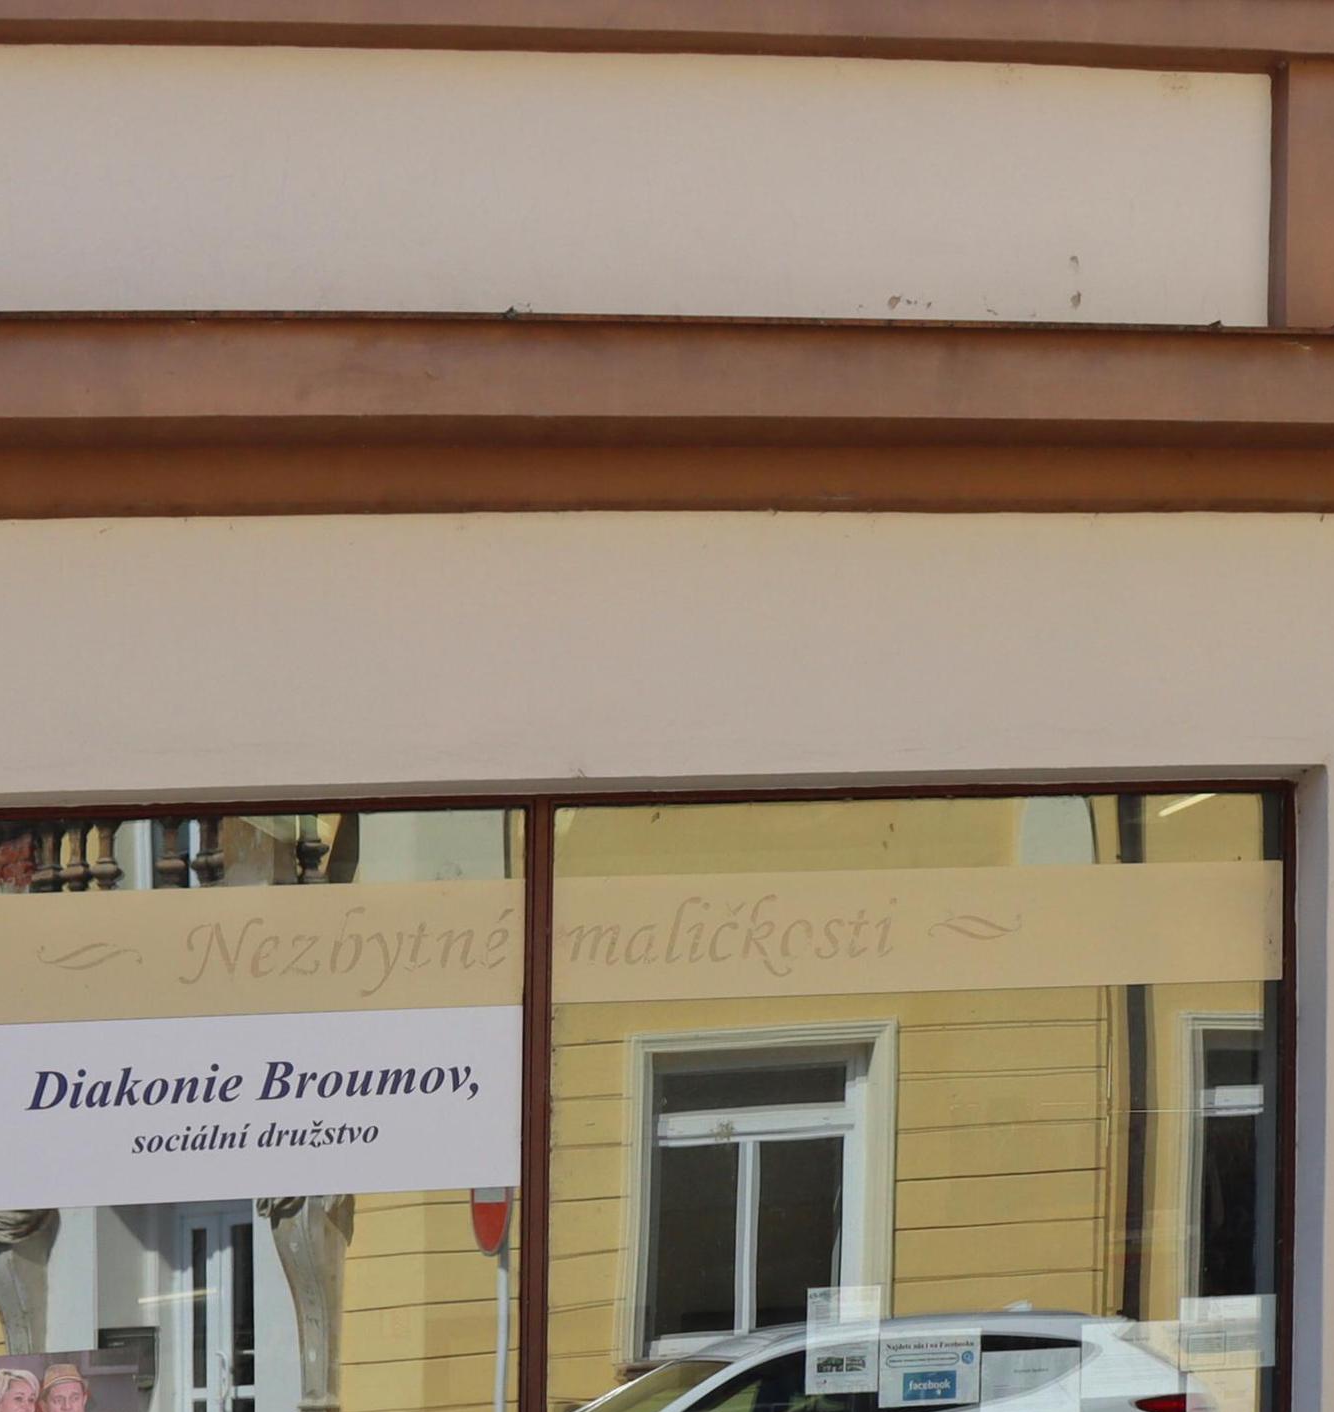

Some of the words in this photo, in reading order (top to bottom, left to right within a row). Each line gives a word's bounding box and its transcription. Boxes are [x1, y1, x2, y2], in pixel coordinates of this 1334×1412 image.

[178, 905, 517, 997] Nezbytné
[563, 892, 898, 977] maličkosti
[27, 1063, 242, 1112] Diakonie
[255, 1058, 482, 1103] Broumov,
[131, 1123, 249, 1155] sociální
[256, 1119, 380, 1151] družstvo
[908, 1378, 951, 1391] facebook
